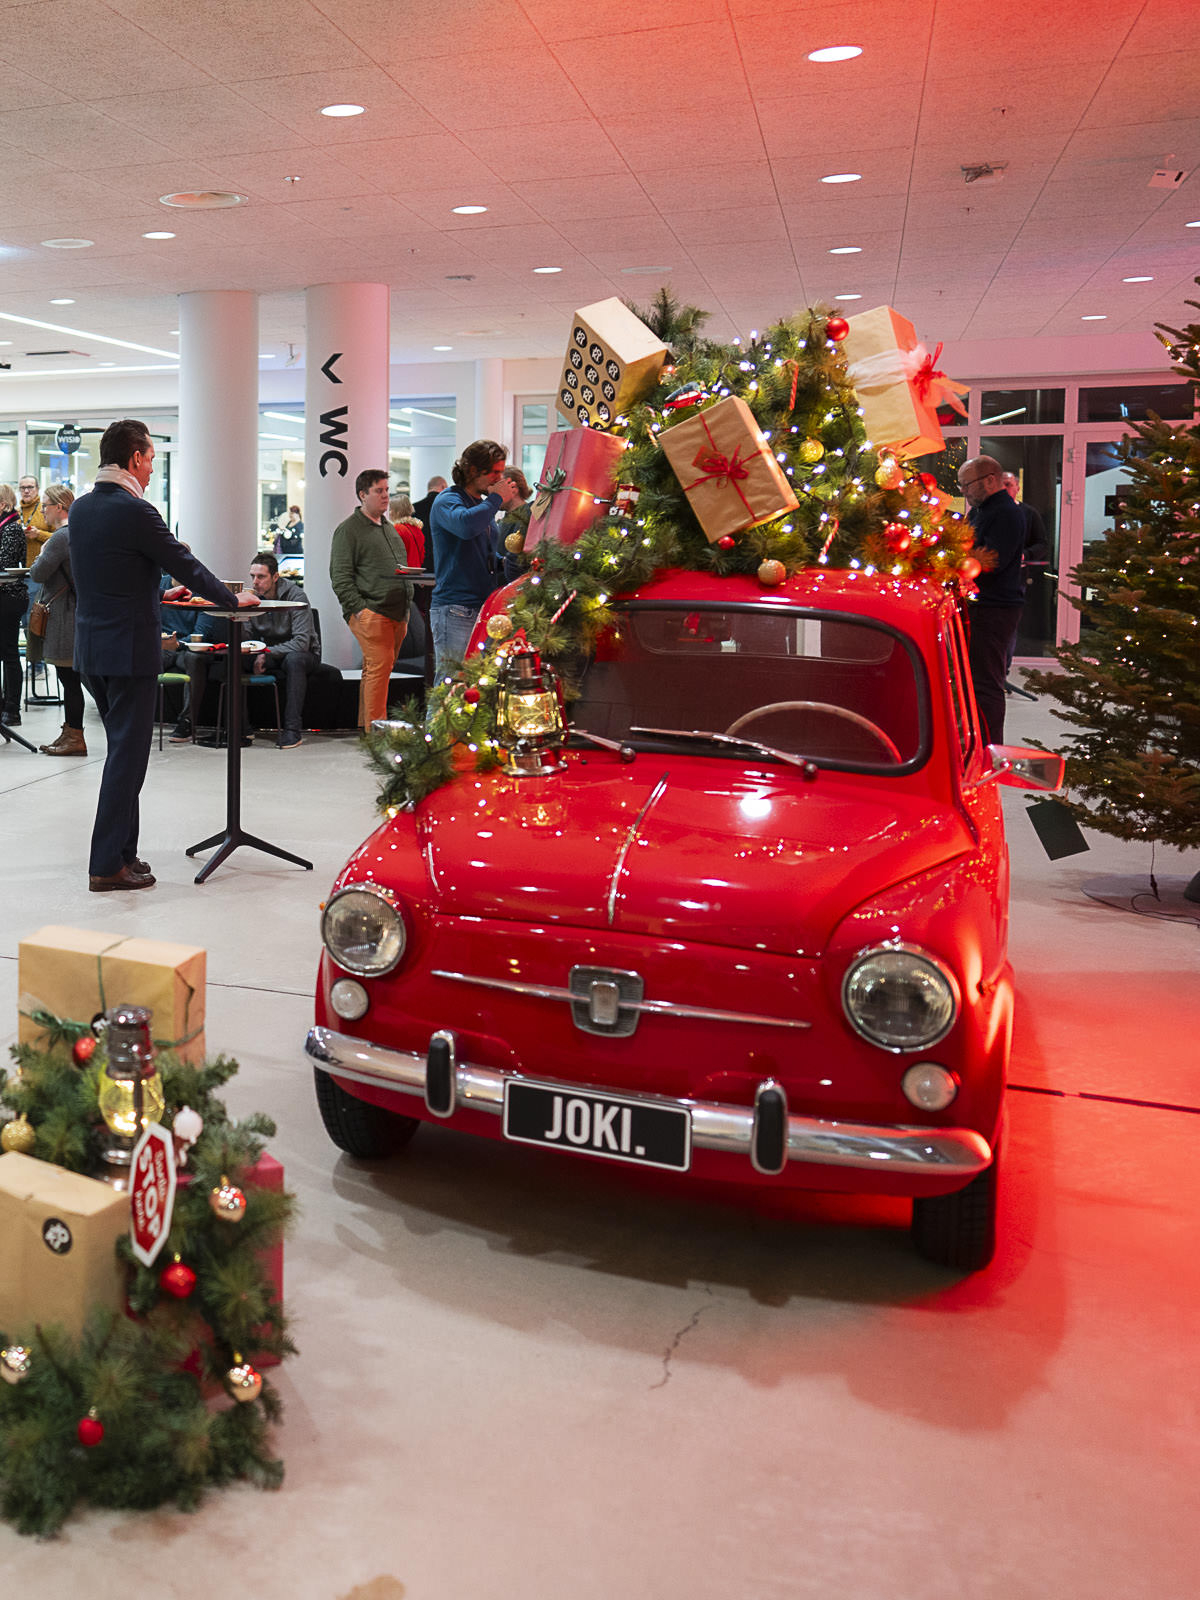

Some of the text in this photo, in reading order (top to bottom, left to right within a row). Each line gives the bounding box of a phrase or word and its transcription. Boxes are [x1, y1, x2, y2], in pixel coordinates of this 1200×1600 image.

[319, 405, 348, 478] WC
[544, 1096, 646, 1156] JOKI.
[139, 1144, 161, 1238] STOP
